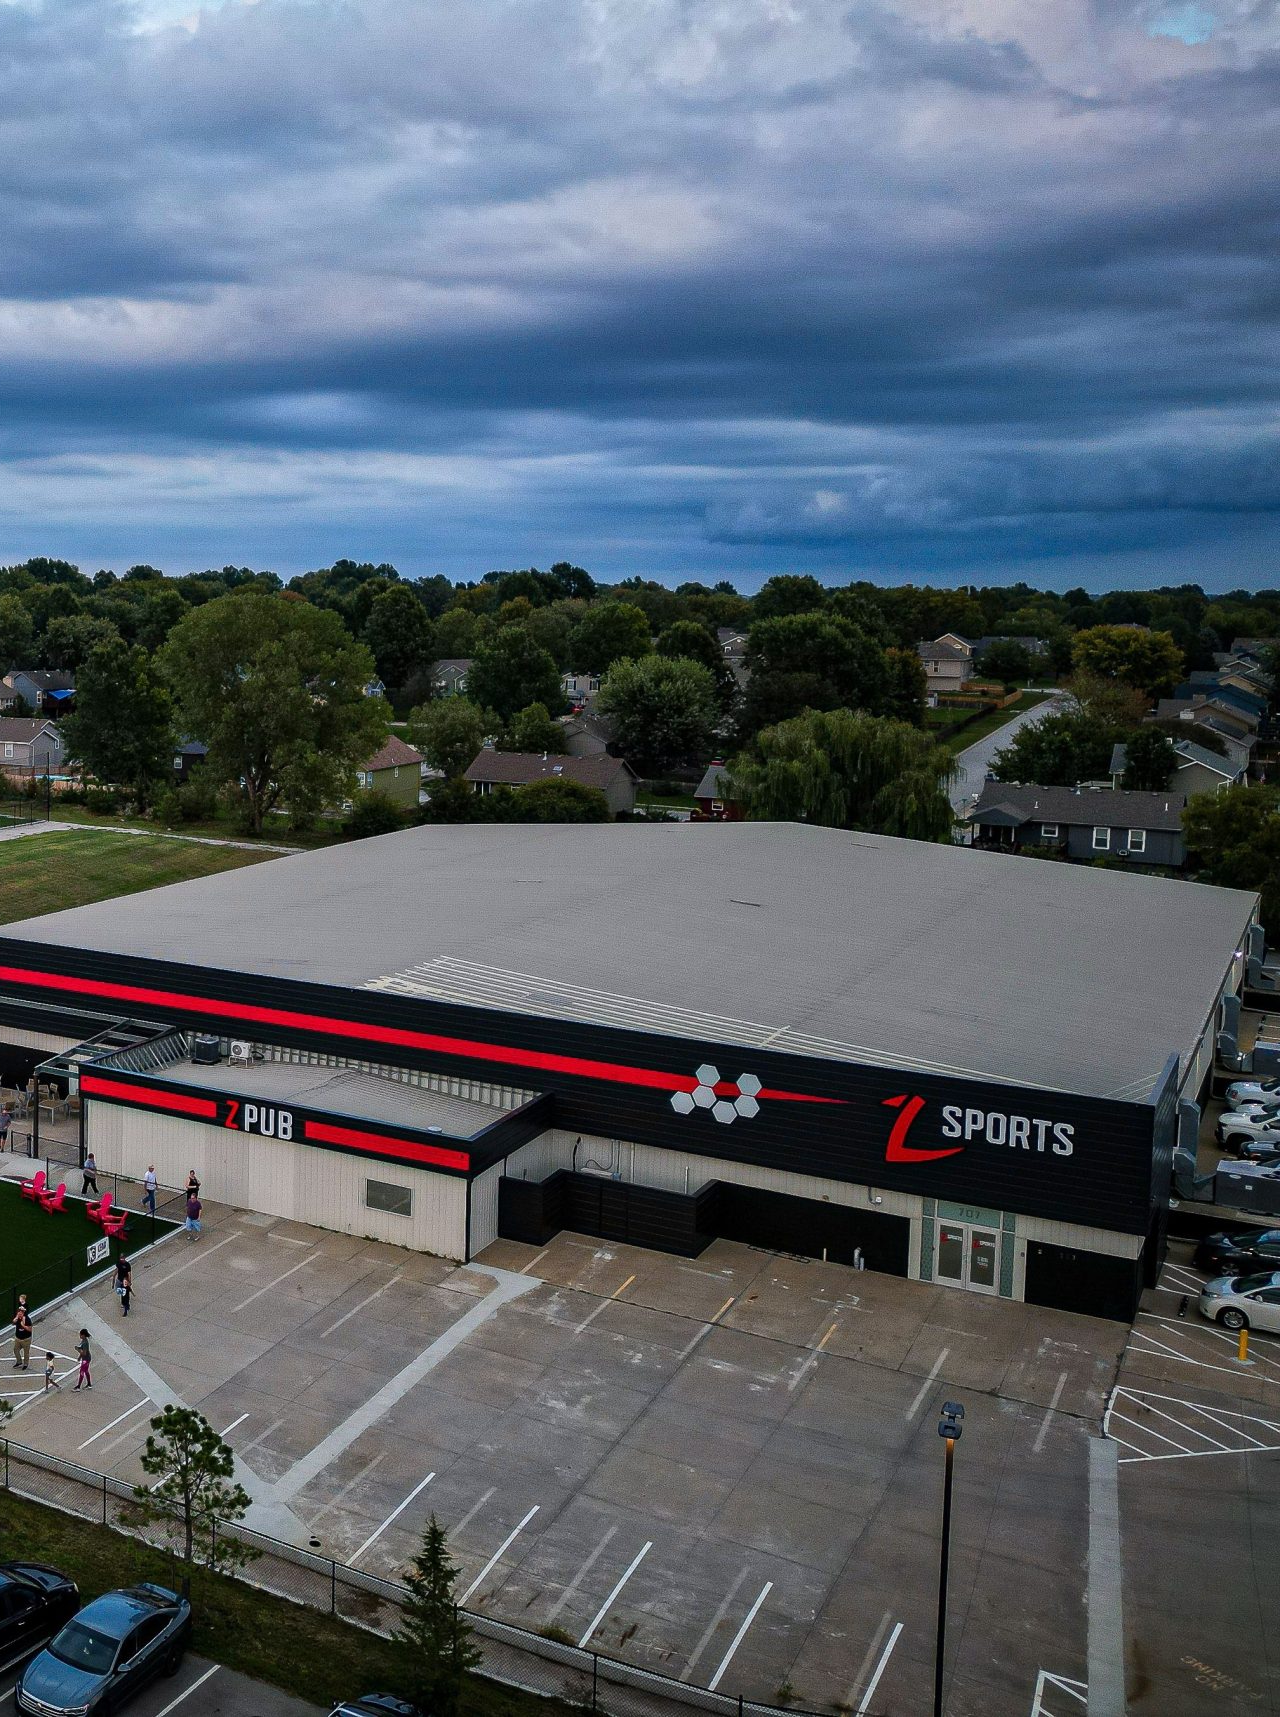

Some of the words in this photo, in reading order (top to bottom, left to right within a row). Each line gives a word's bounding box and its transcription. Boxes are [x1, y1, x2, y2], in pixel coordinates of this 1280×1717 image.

[224, 1099, 240, 1129] Z
[244, 1104, 293, 1140] PUB
[942, 1105, 1075, 1156] SPORTS
[958, 1207, 981, 1219] 707
